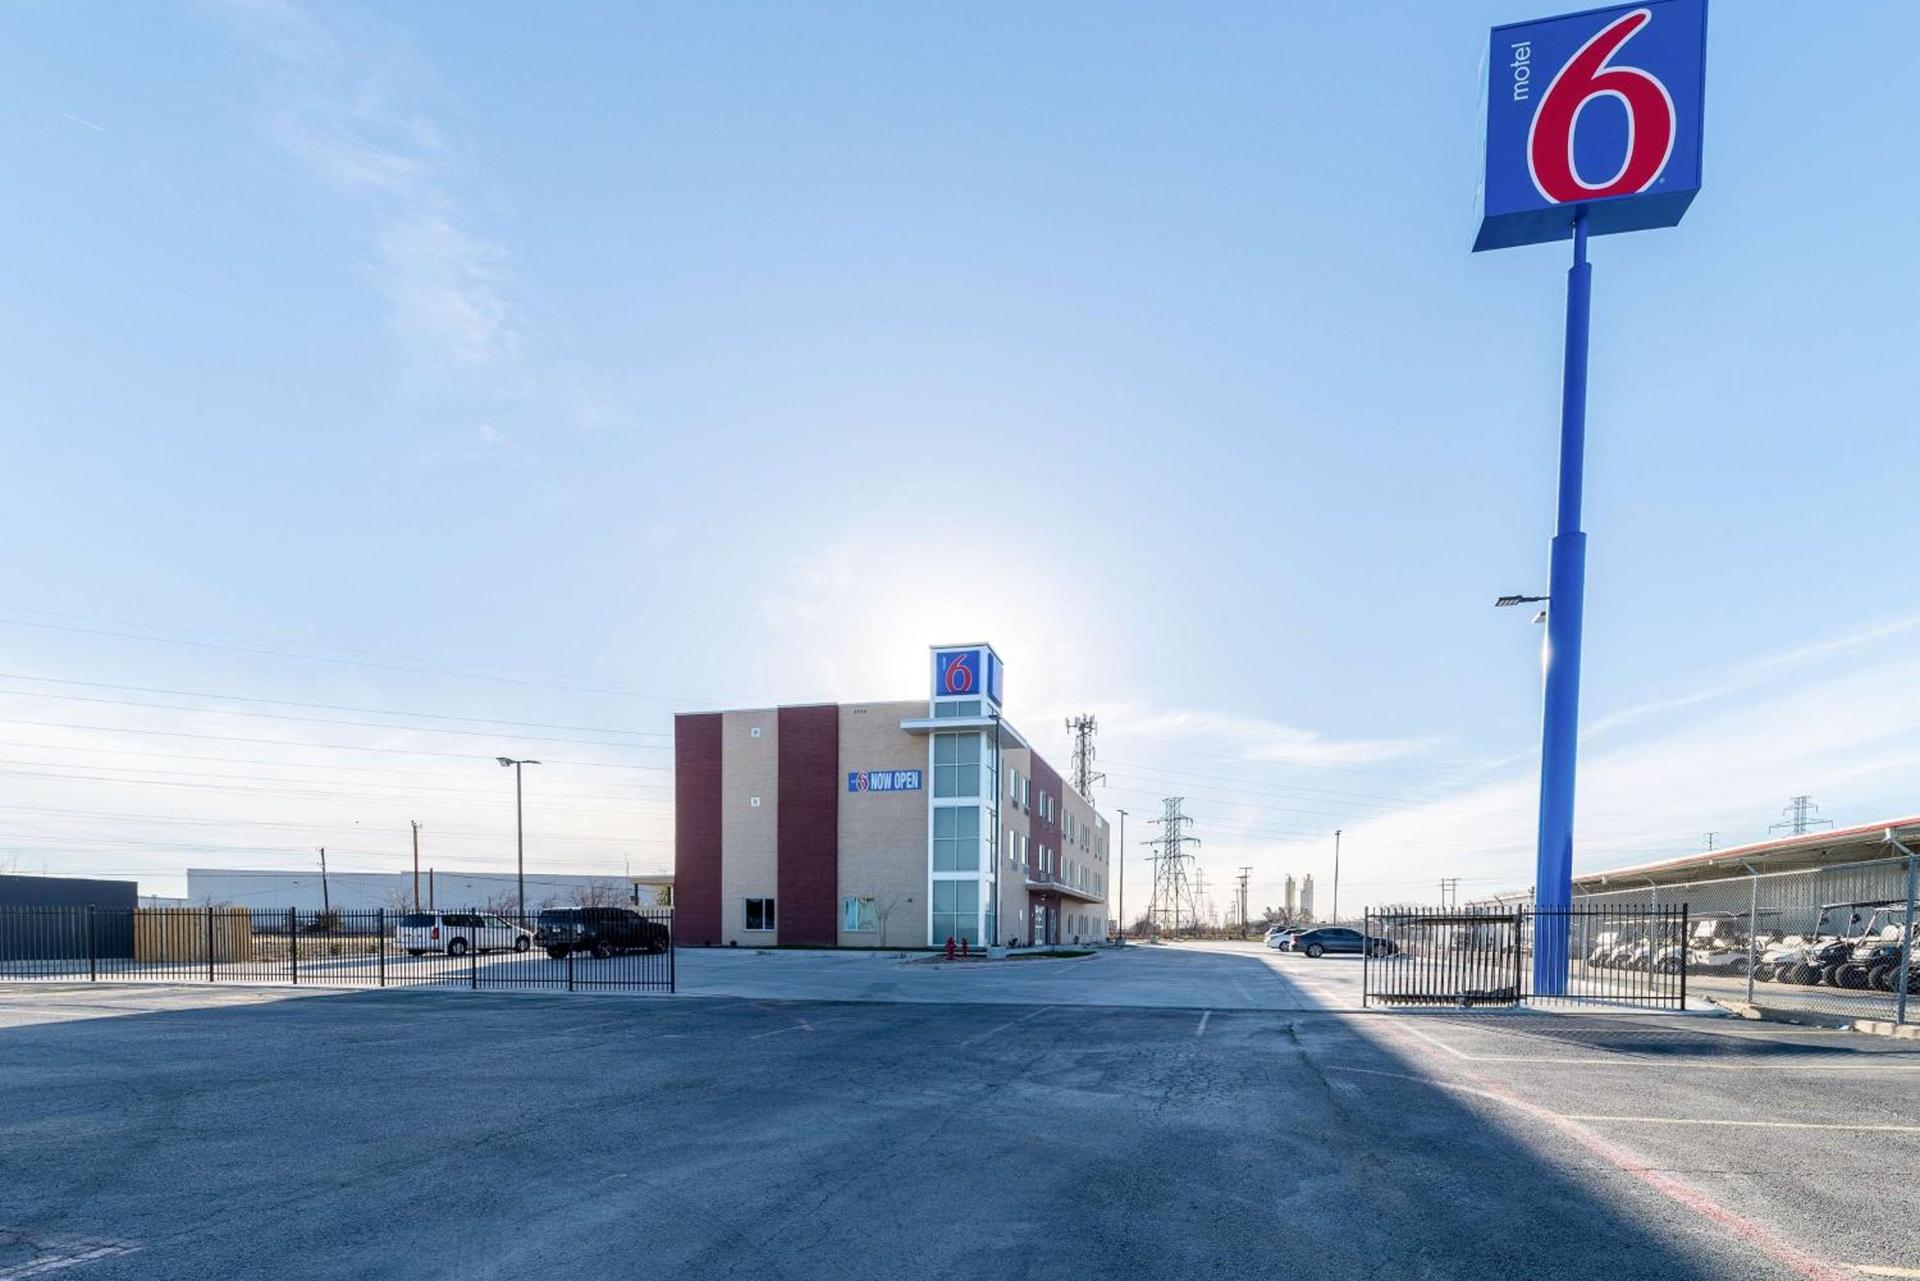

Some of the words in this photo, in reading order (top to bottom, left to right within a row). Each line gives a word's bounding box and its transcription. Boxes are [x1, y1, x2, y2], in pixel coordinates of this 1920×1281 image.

[1510, 41, 1531, 101] motel
[1527, 9, 1676, 204] 6
[945, 653, 972, 694] 6
[871, 772, 892, 790] NOW
[894, 771, 919, 789] OPEN
